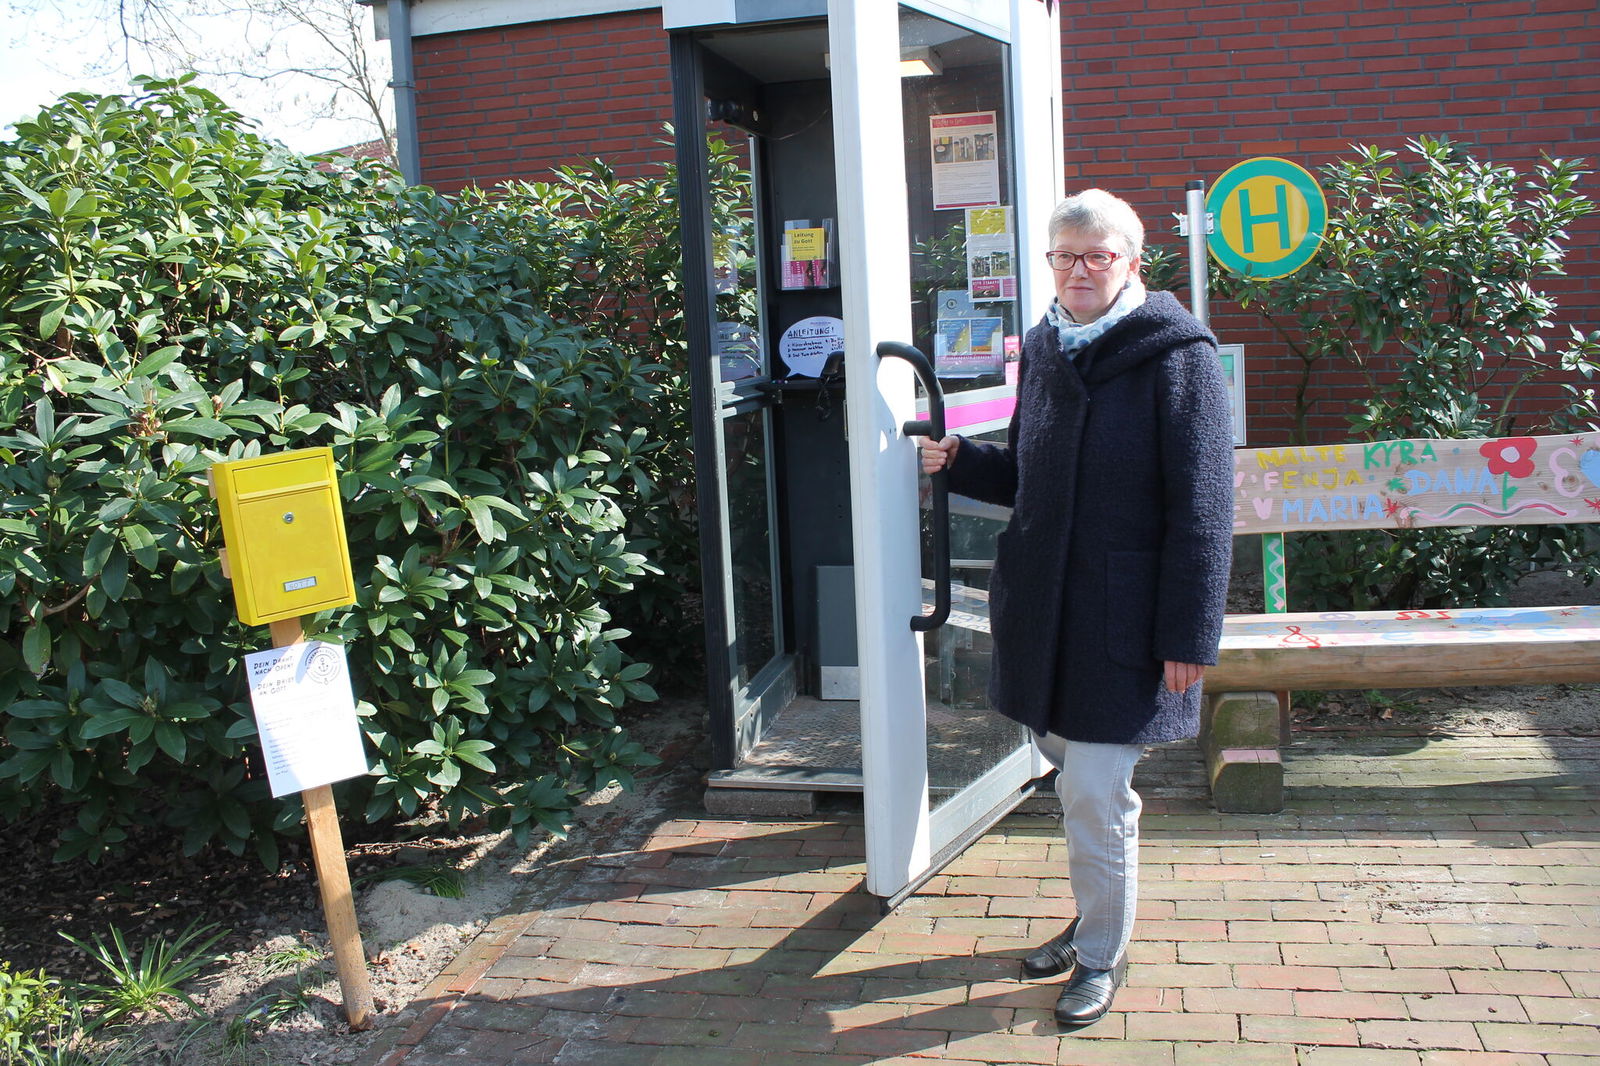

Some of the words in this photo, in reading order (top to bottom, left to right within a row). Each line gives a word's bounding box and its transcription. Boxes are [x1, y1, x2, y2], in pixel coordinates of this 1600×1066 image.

[1238, 184, 1291, 254] H
[1256, 446, 1347, 470] MALTE
[1364, 440, 1438, 469] KYRA
[1281, 494, 1386, 523] MARIA
[253, 660, 269, 669] DEIN
